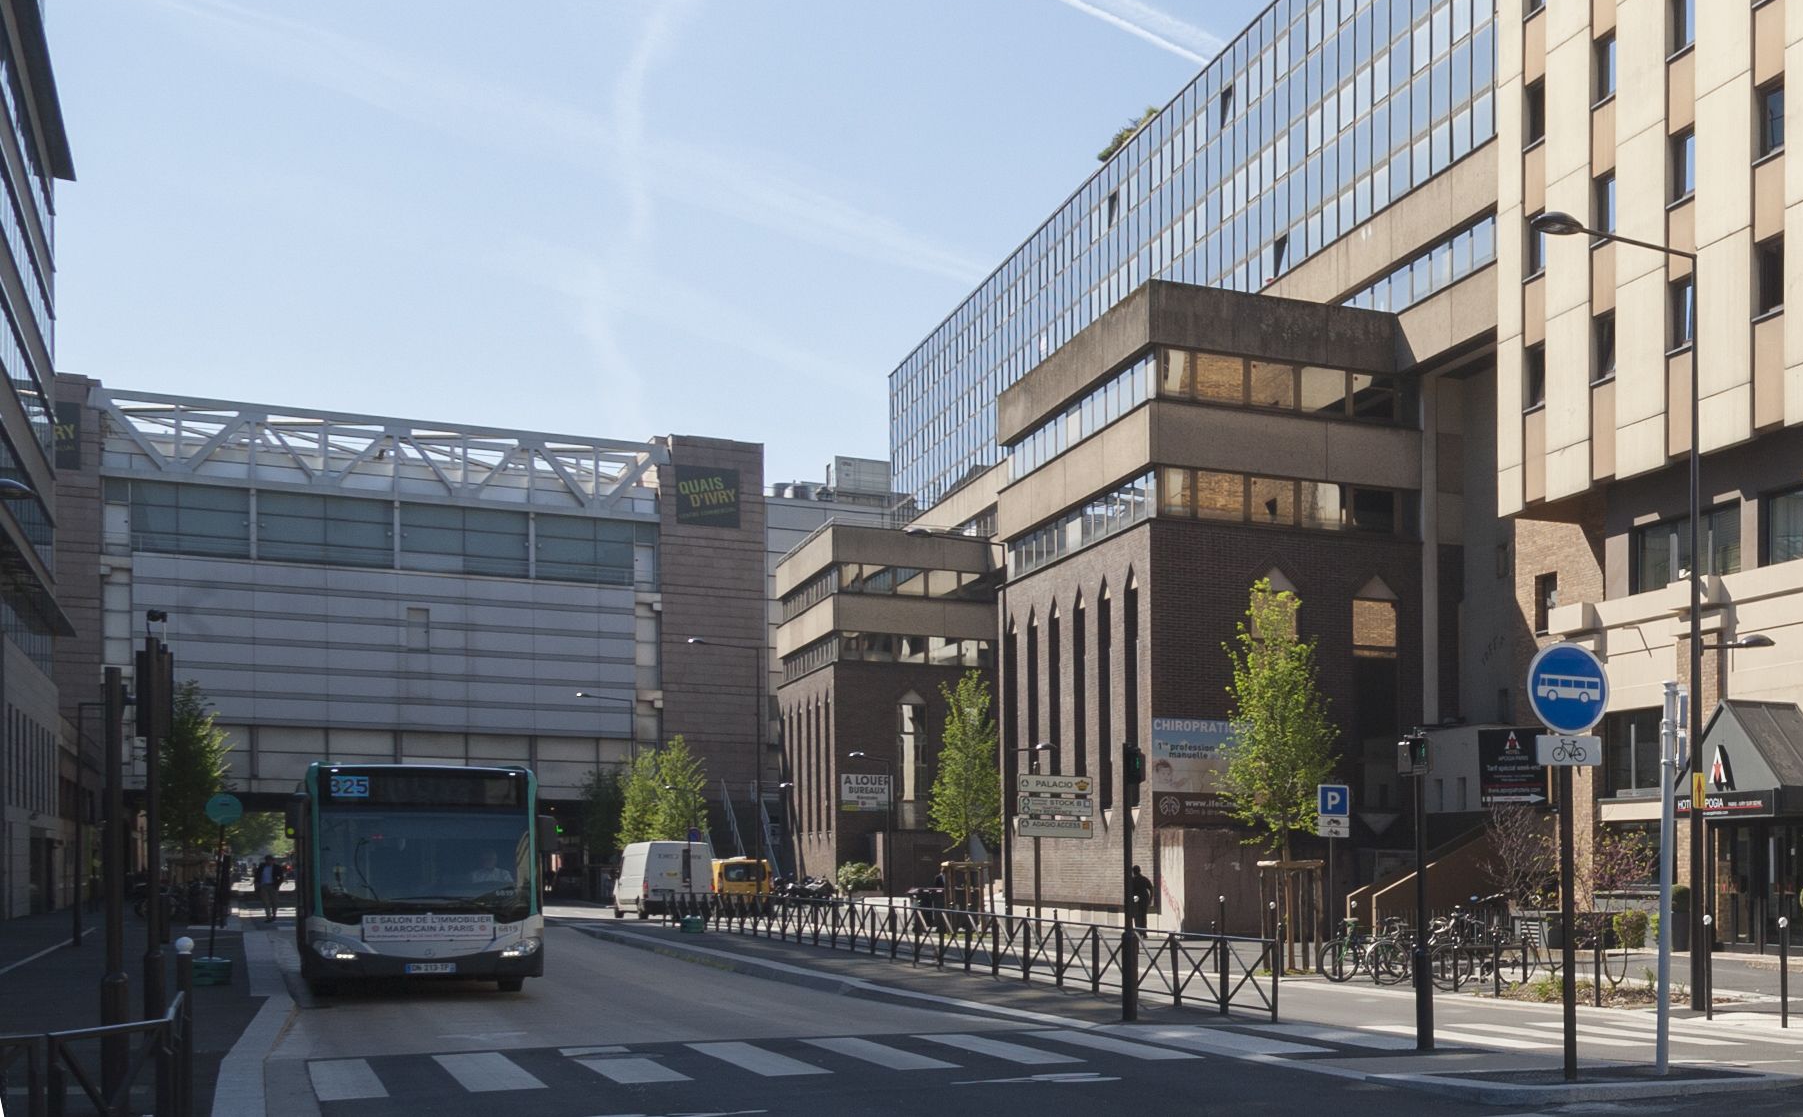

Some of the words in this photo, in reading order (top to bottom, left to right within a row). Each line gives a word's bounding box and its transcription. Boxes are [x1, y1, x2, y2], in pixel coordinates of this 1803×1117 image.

[679, 477, 724, 495] QUAIS
[689, 489, 736, 507] D'IVRY
[1154, 719, 1258, 735] CHIROPRATIQ
[1170, 743, 1215, 752] profession
[856, 776, 890, 786] LOUER
[1035, 779, 1073, 788] PALACIO
[331, 778, 369, 795] 325
[848, 786, 886, 794] BUREAUX
[1050, 799, 1075, 807] STOCK
[1677, 799, 1691, 810] HOT
[1704, 798, 1724, 808] POGIA
[365, 916, 377, 924] LE
[380, 916, 412, 924] SALON
[416, 916, 428, 924] DE
[432, 915, 492, 924] L'IMMOBILIER
